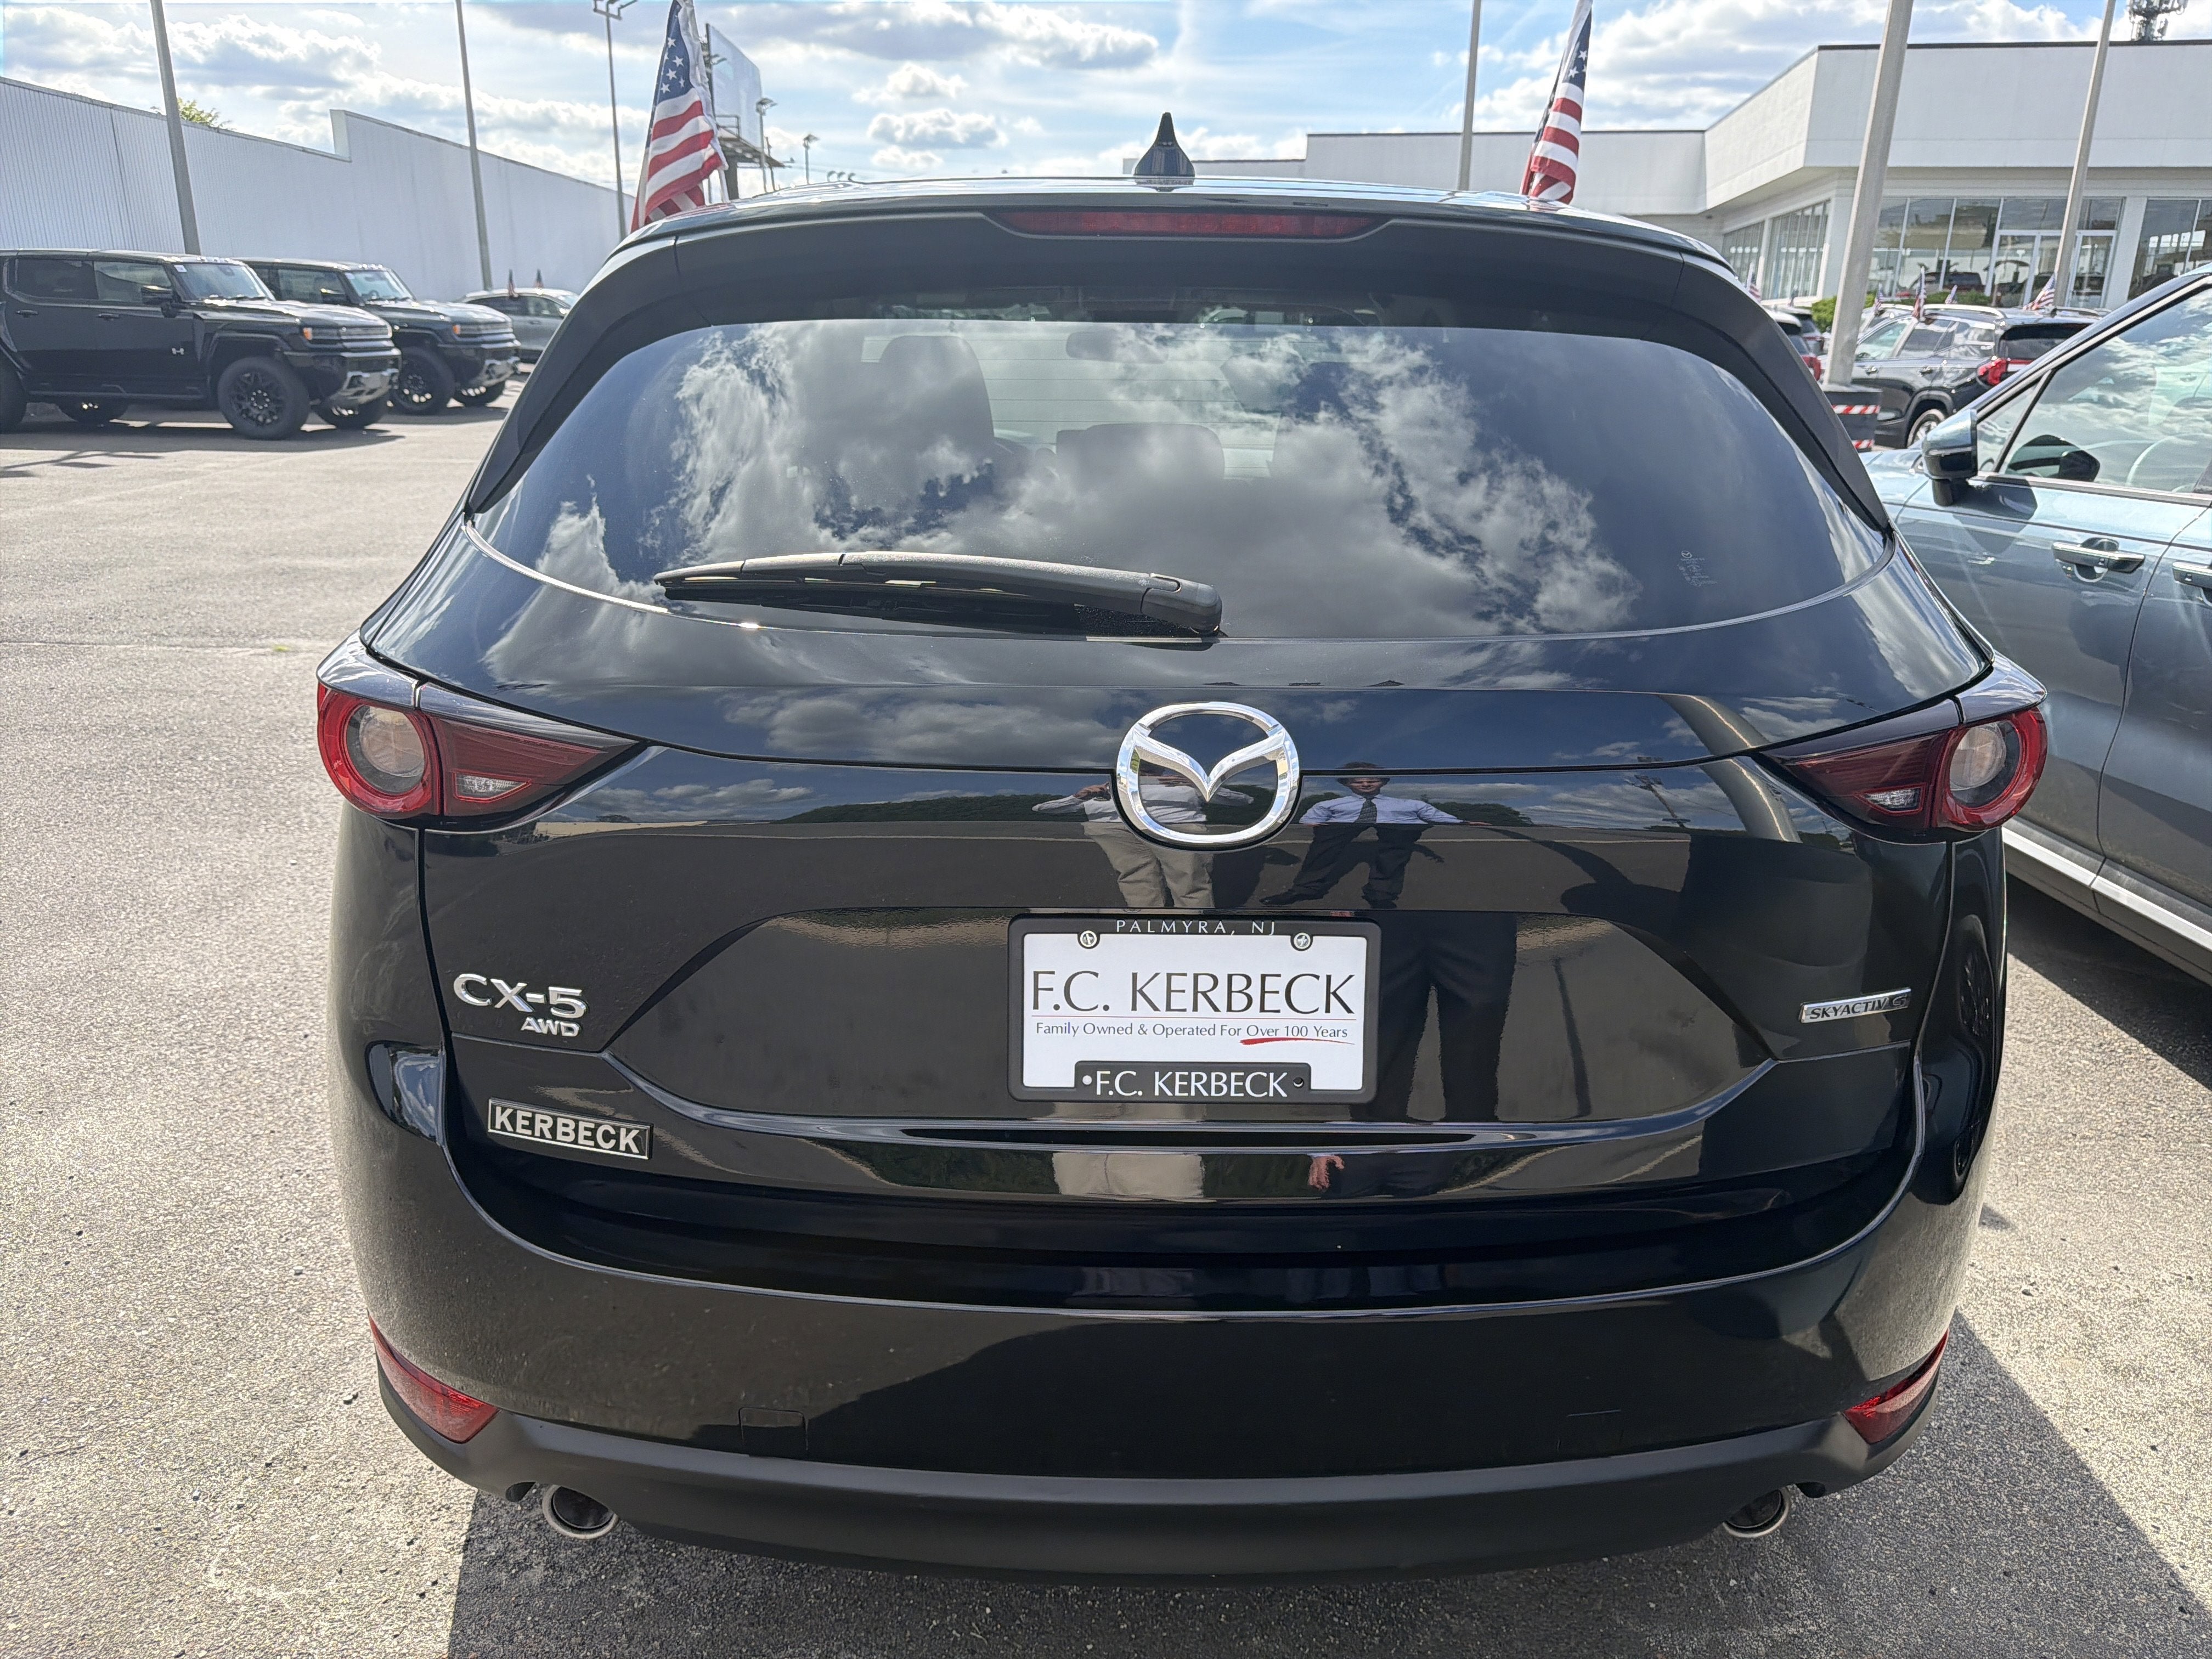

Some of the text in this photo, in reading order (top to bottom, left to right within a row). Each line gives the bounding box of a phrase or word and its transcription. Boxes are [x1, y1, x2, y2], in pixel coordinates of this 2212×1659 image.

[1115, 919, 1276, 935] PALMYRA, NJ
[453, 973, 587, 1018] CX-5
[1032, 970, 1355, 1014] F.C. KERBECK
[1809, 997, 1887, 1019] SKYACTIV
[520, 1017, 580, 1037] AWD
[1036, 1022, 1347, 1039] Family Owned & Operated For Over 100 Years
[1096, 1070, 1288, 1098] F.C. KERBECK
[495, 1106, 640, 1154] KERBECK
